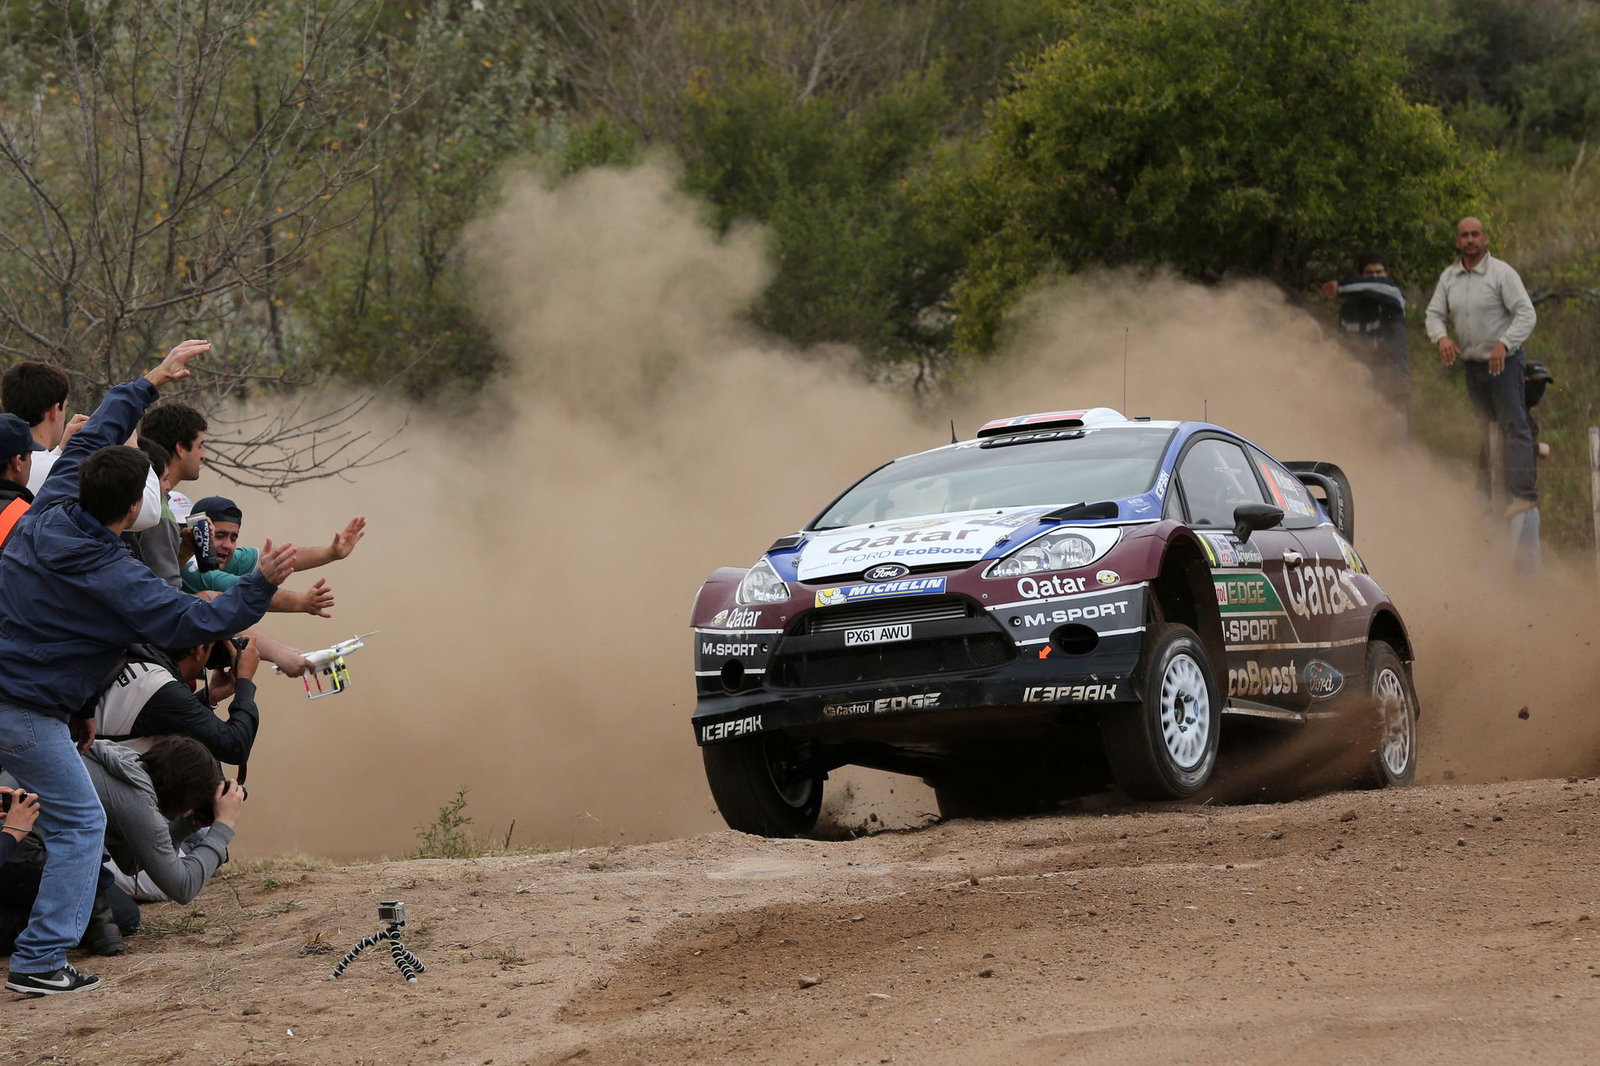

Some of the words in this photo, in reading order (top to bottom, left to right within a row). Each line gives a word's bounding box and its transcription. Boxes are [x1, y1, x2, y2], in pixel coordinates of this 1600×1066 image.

[828, 529, 980, 555] Qatar
[842, 551, 892, 565] FORD
[894, 547, 983, 557] EcoBoost
[873, 567, 898, 579] Ford
[848, 578, 943, 597] MICHELIN
[1017, 575, 1086, 599] Qatar
[1228, 582, 1266, 605] EDGE
[1283, 551, 1368, 621] Qatar
[725, 607, 762, 629] Qatar
[1023, 601, 1128, 627] M-SPORT
[846, 629, 875, 644] PX61
[880, 625, 910, 640] AWU
[702, 642, 758, 656] M-SPORT
[1309, 664, 1335, 693] Ford
[836, 702, 870, 716] Castrol
[874, 692, 941, 713] EDGE
